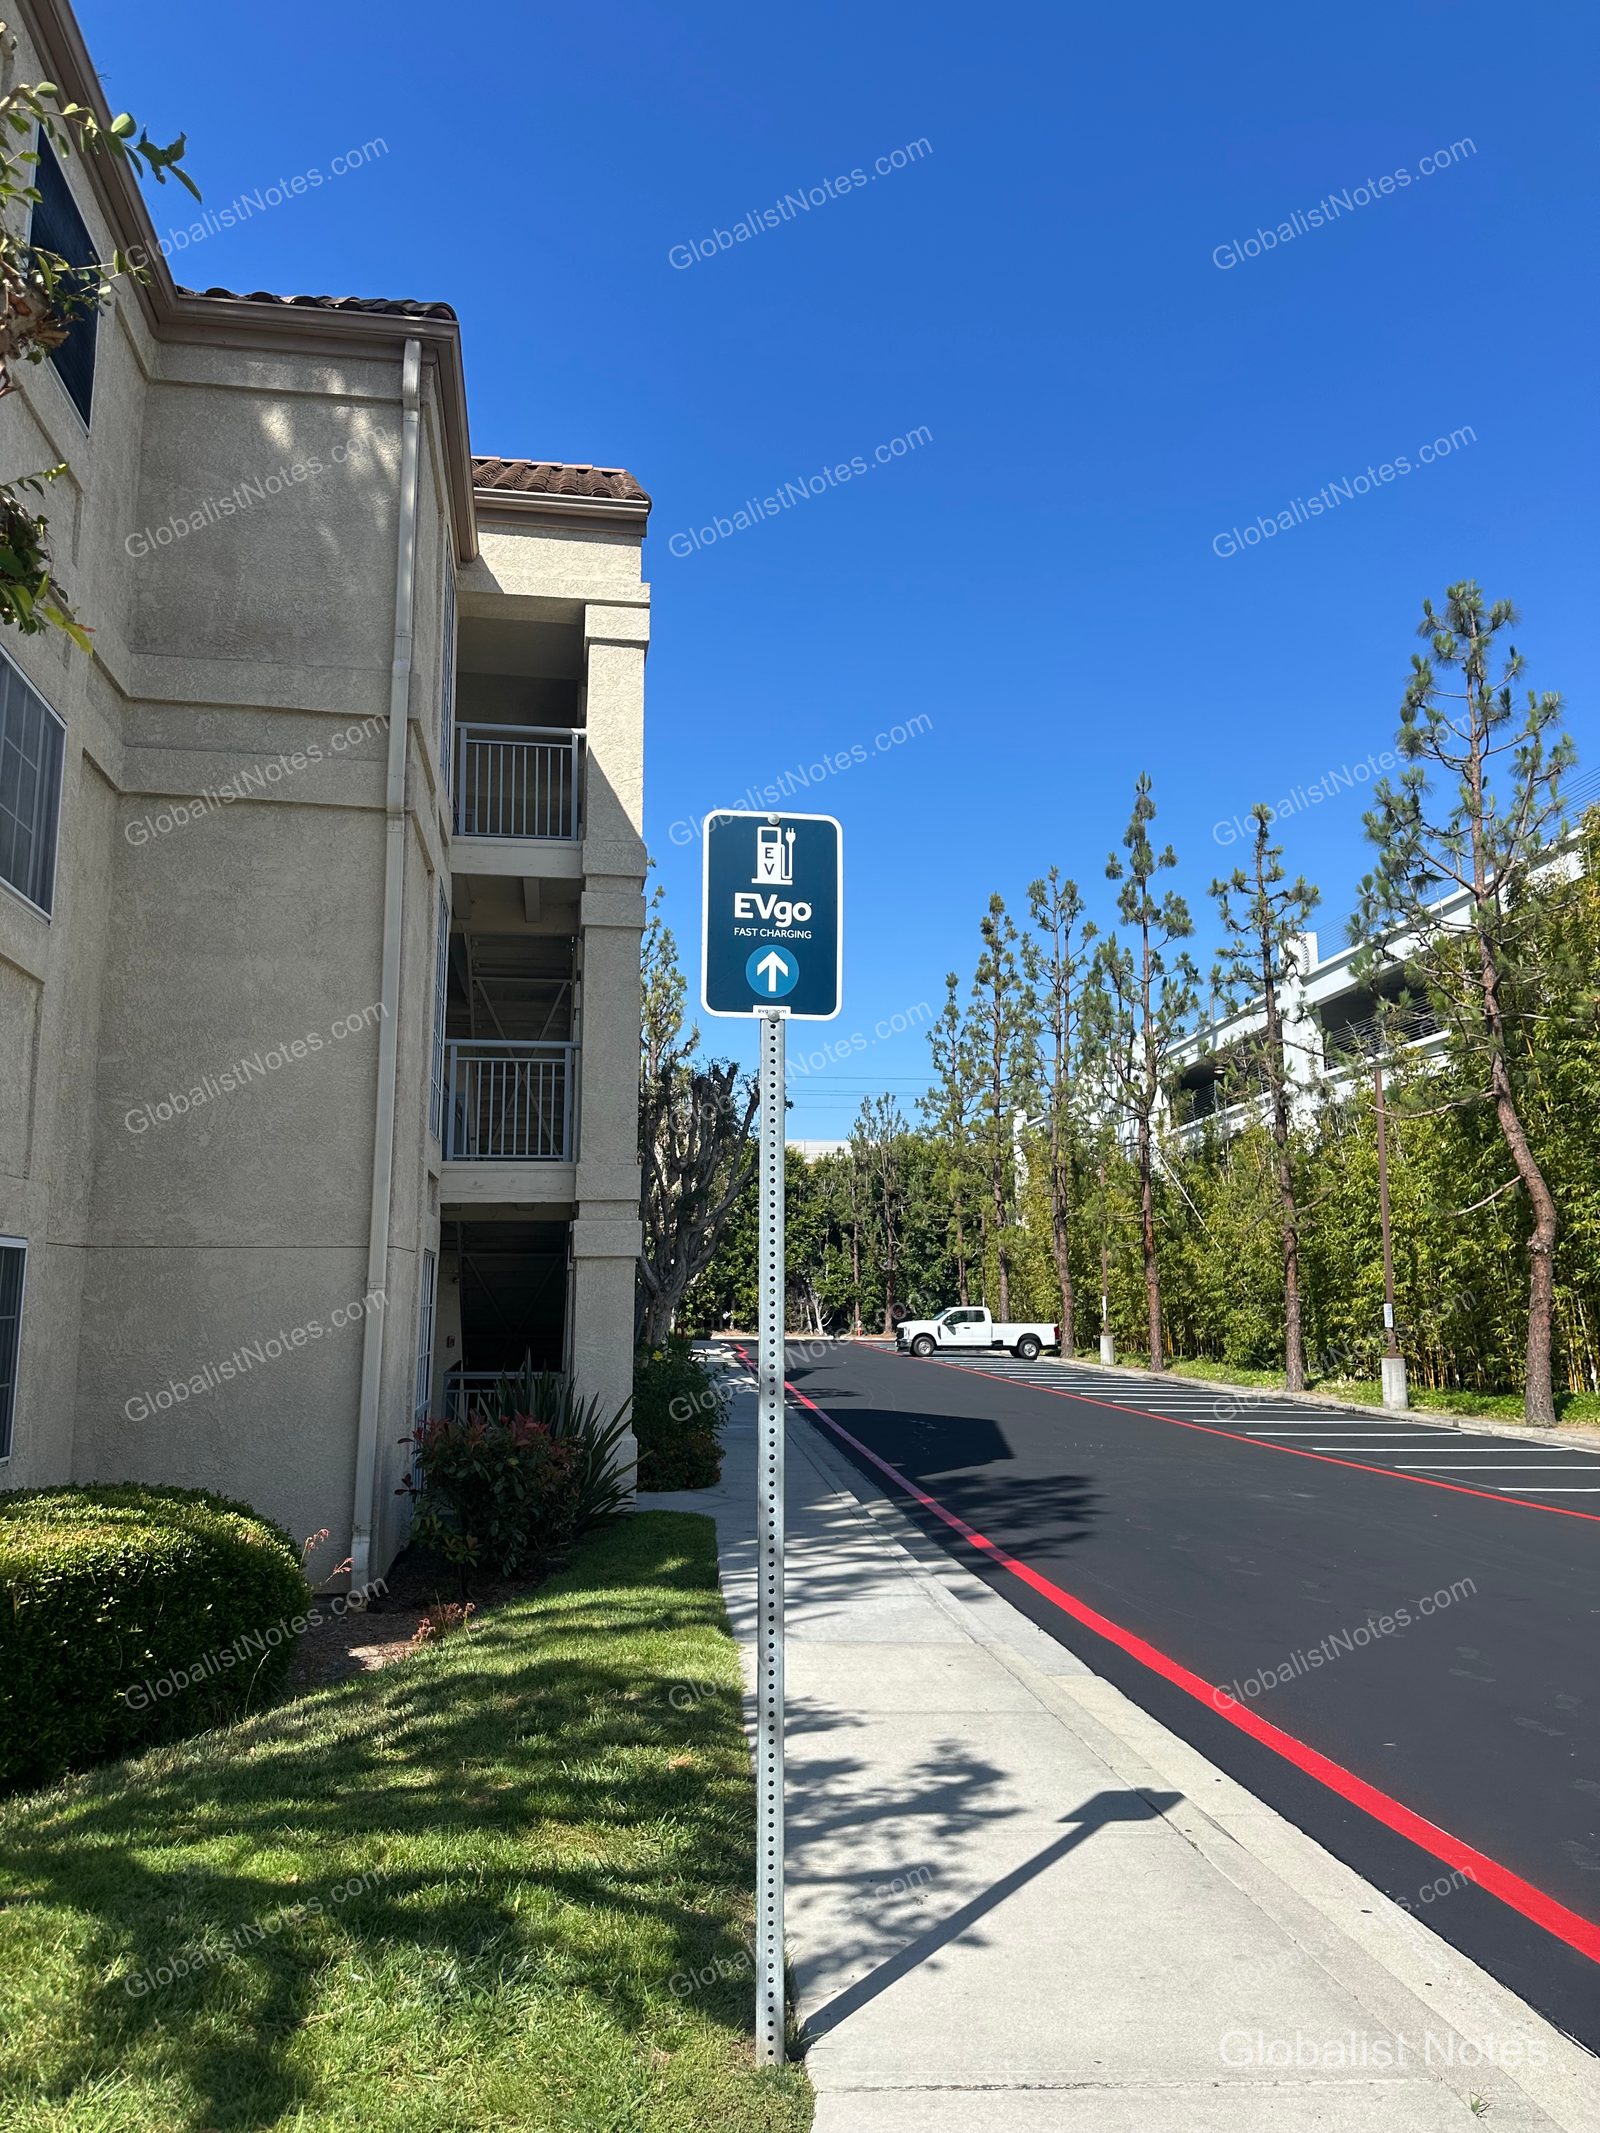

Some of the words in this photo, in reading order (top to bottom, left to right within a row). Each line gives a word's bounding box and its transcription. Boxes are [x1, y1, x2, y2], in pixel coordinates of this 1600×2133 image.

[734, 892, 812, 928] EVgo
[733, 927, 758, 938] FAST
[759, 928, 812, 939] CHARGING
